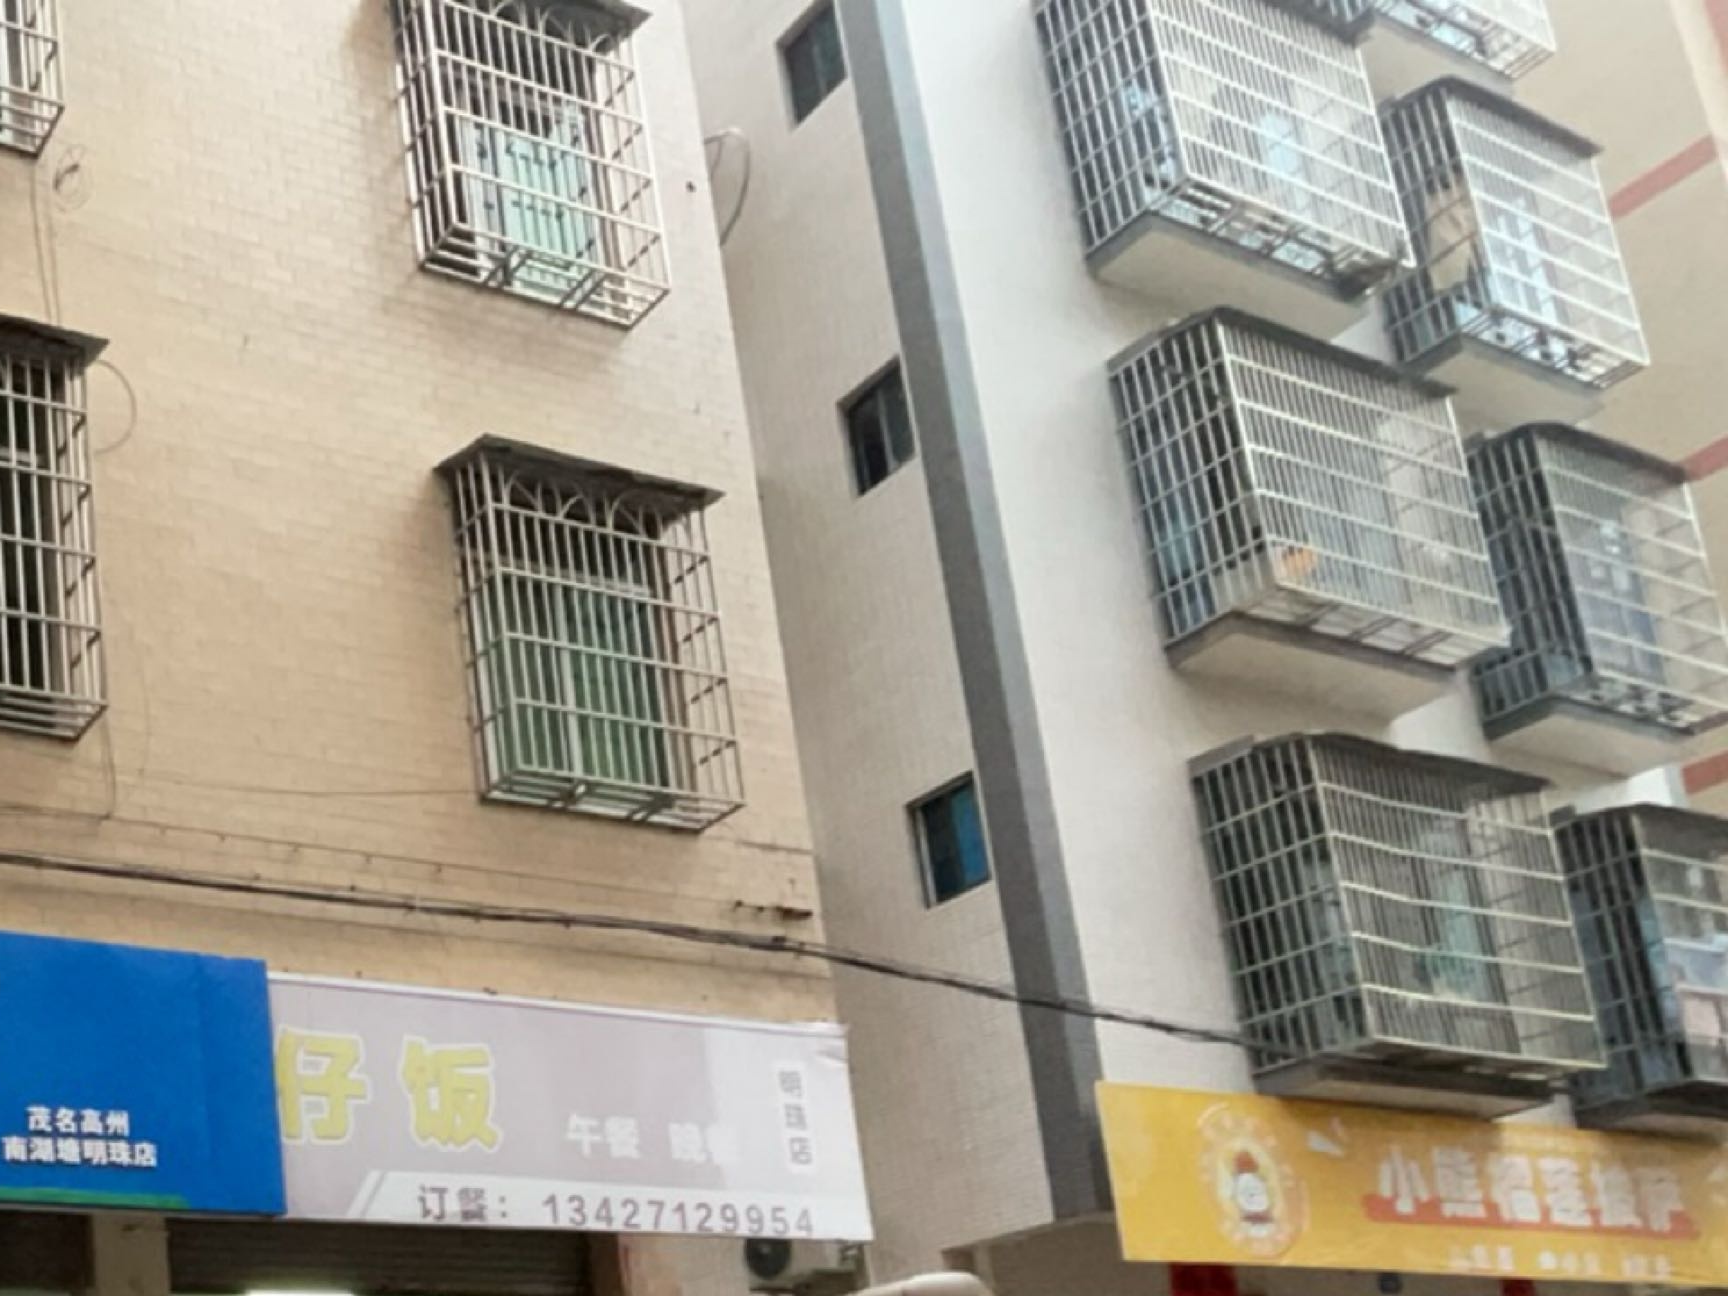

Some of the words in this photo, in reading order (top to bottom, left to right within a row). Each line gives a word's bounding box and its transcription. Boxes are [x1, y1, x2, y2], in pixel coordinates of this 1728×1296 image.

[275, 1029, 501, 1151] 仔饭
[26, 1104, 131, 1137] 茂名高州
[541, 1193, 815, 1238] 13427129954
